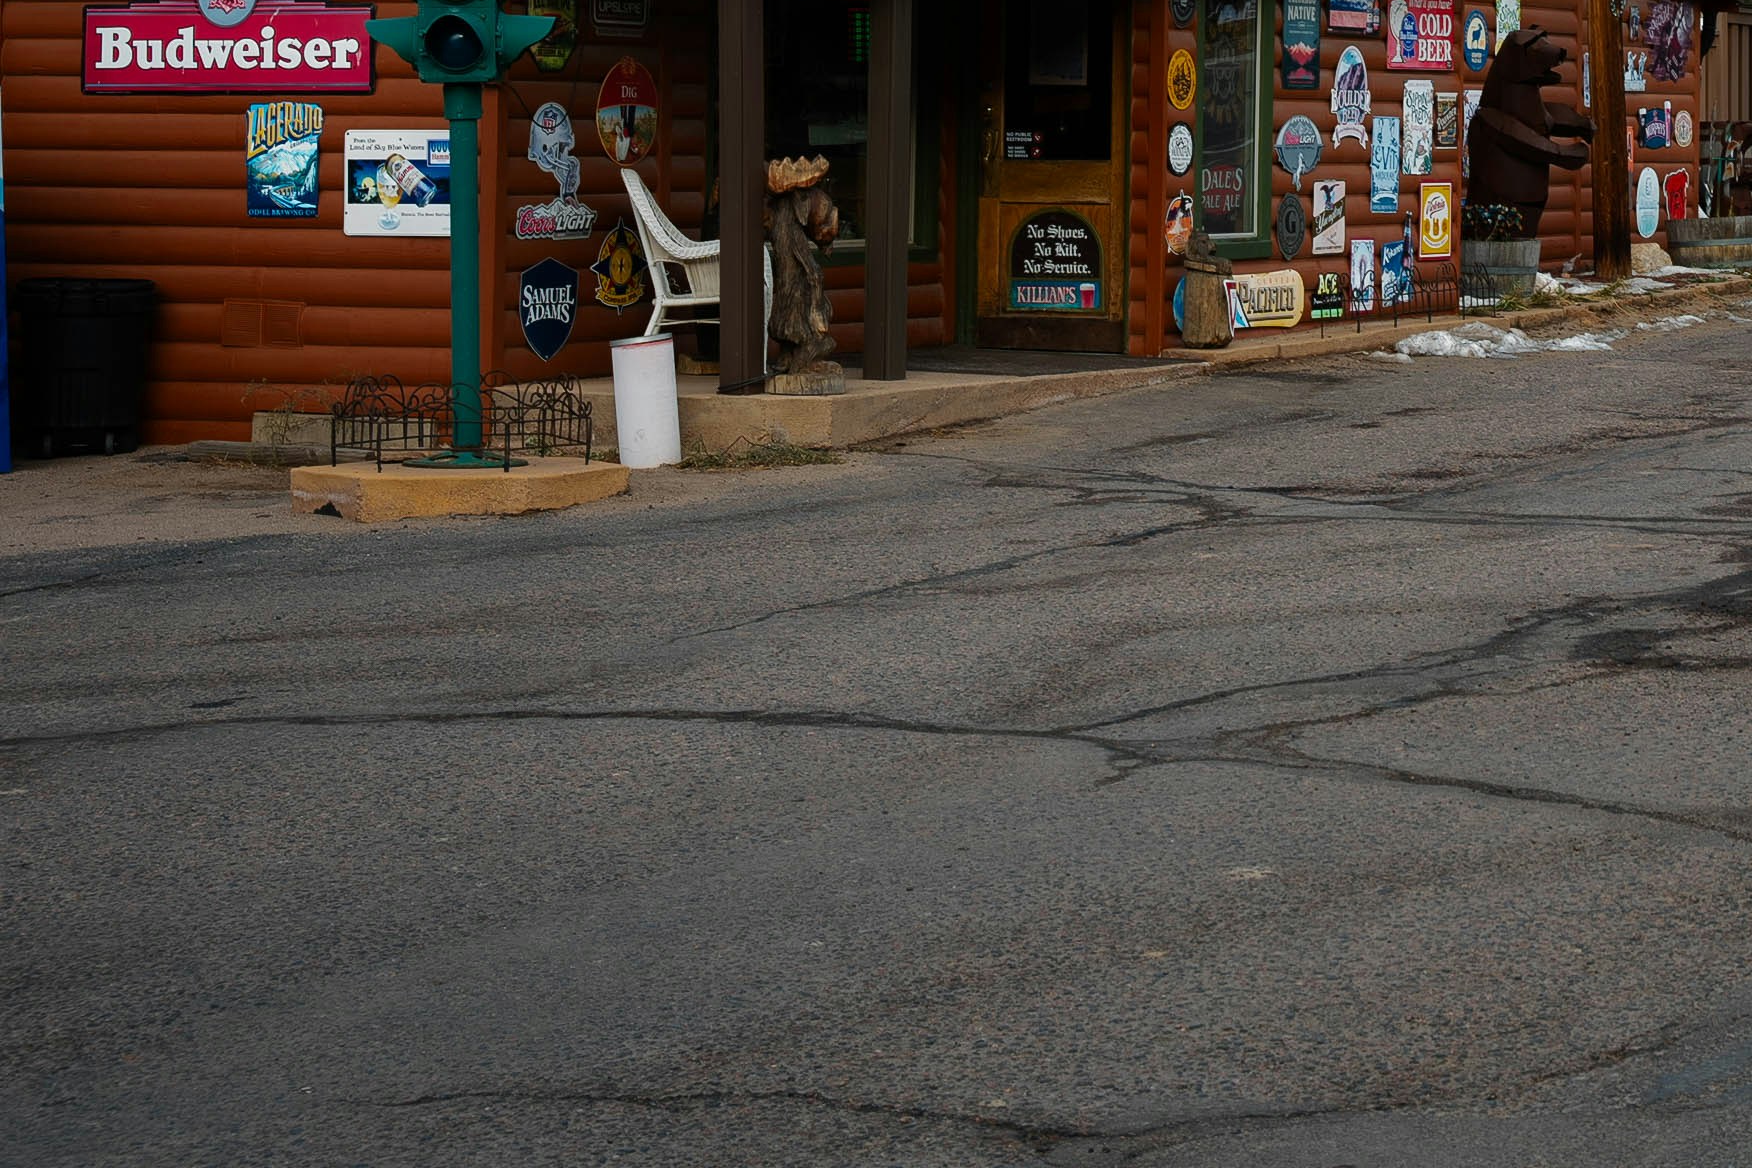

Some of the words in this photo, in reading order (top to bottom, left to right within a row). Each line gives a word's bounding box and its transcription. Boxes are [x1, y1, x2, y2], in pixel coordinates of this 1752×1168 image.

[1287, 5, 1316, 22] NATIVE
[1419, 13, 1453, 37] COLD
[95, 25, 359, 70] Budweiser
[1418, 38, 1453, 62] BEER
[366, 143, 373, 151] of
[374, 144, 386, 152] Sky
[1299, 134, 1316, 144] LIGHT
[1202, 167, 1243, 192] DALE'S
[1223, 194, 1241, 211] ALE
[519, 209, 557, 235] Coors
[556, 213, 595, 232] LIGHT
[1027, 224, 1045, 239] No
[1034, 242, 1052, 257] No
[1023, 259, 1041, 274] No
[1317, 274, 1338, 295] ACE
[522, 284, 575, 308] SAMUEL
[1016, 286, 1077, 304] KILLIAN'S
[525, 303, 570, 327] ADAMS
